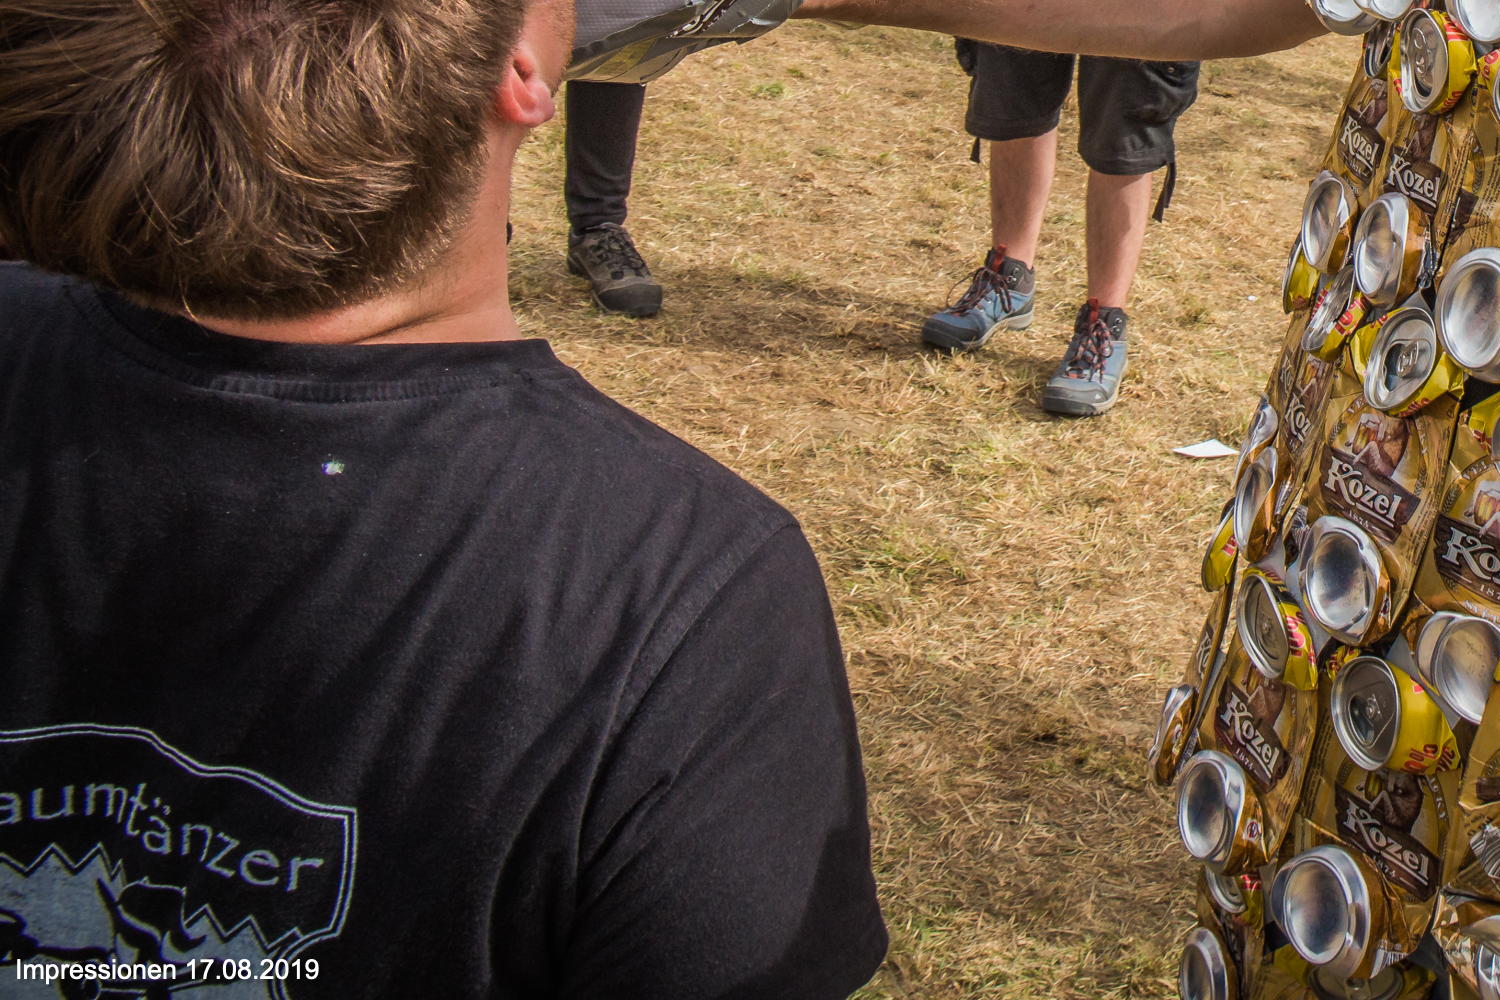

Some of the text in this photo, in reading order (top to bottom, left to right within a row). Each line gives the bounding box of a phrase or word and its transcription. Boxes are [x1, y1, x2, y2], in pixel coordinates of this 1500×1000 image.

[1340, 115, 1379, 166] Kozel
[1388, 154, 1441, 201] Kozel
[1283, 394, 1314, 443] Koz
[1324, 456, 1402, 522] Kozel
[1220, 691, 1280, 775] Kozel
[1235, 748, 1254, 771] 1874
[1342, 799, 1430, 881] Kozel
